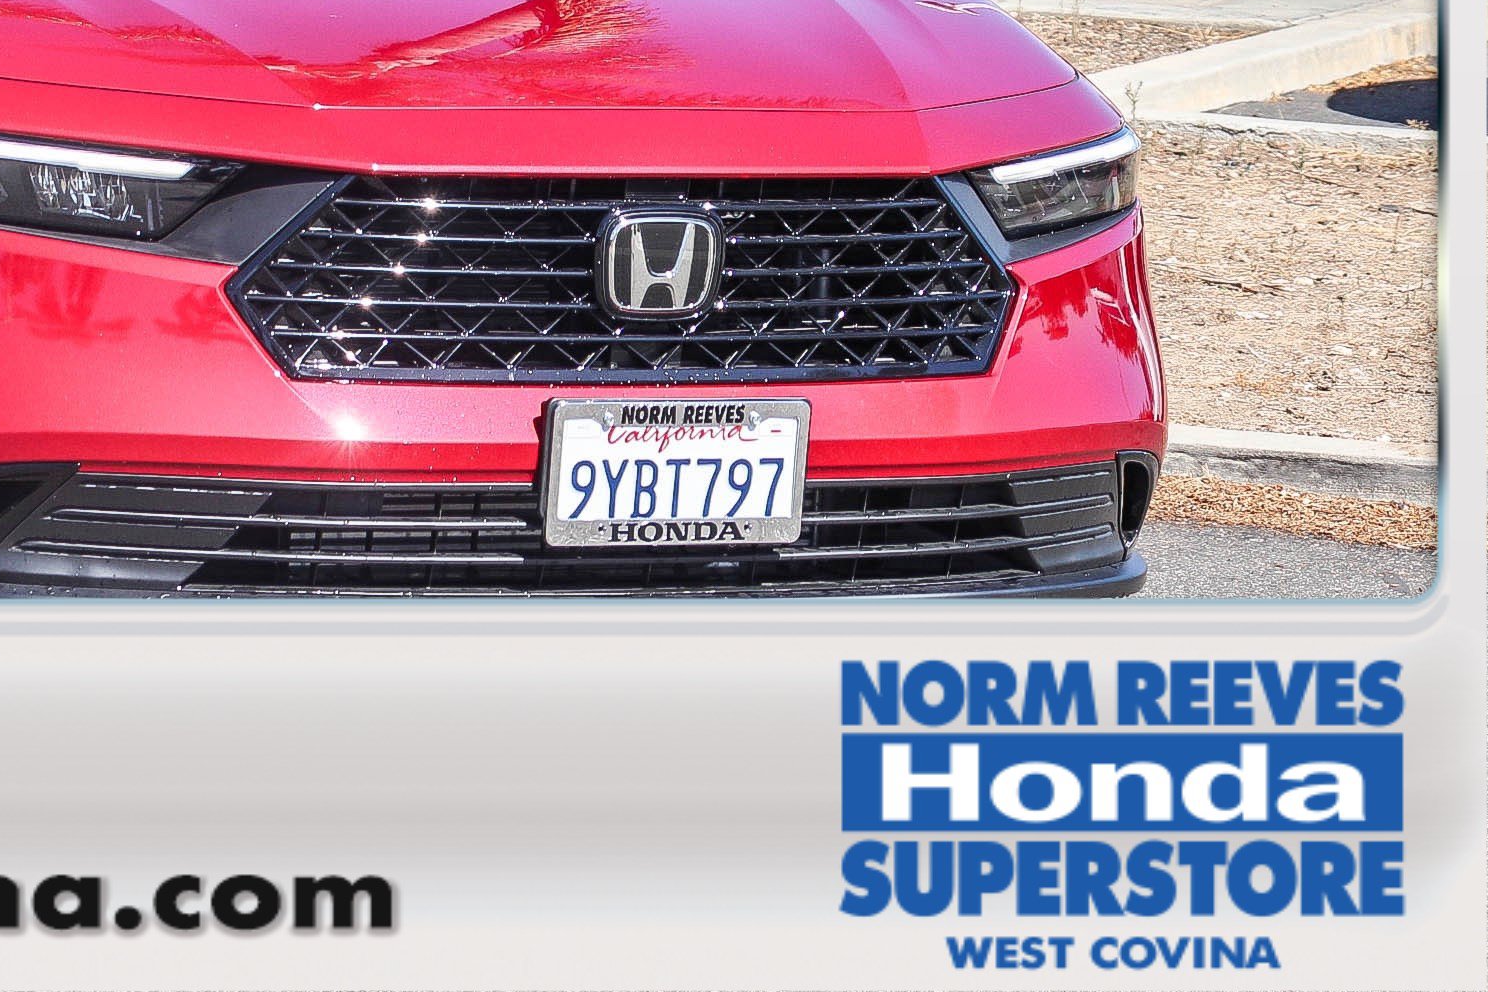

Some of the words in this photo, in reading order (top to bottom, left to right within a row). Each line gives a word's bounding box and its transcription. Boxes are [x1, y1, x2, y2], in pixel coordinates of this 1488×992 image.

[621, 405, 677, 425] NORM
[683, 404, 745, 424] REEVES
[607, 425, 759, 453] California
[568, 458, 785, 519] 9YBT797
[607, 522, 745, 543] HONDA
